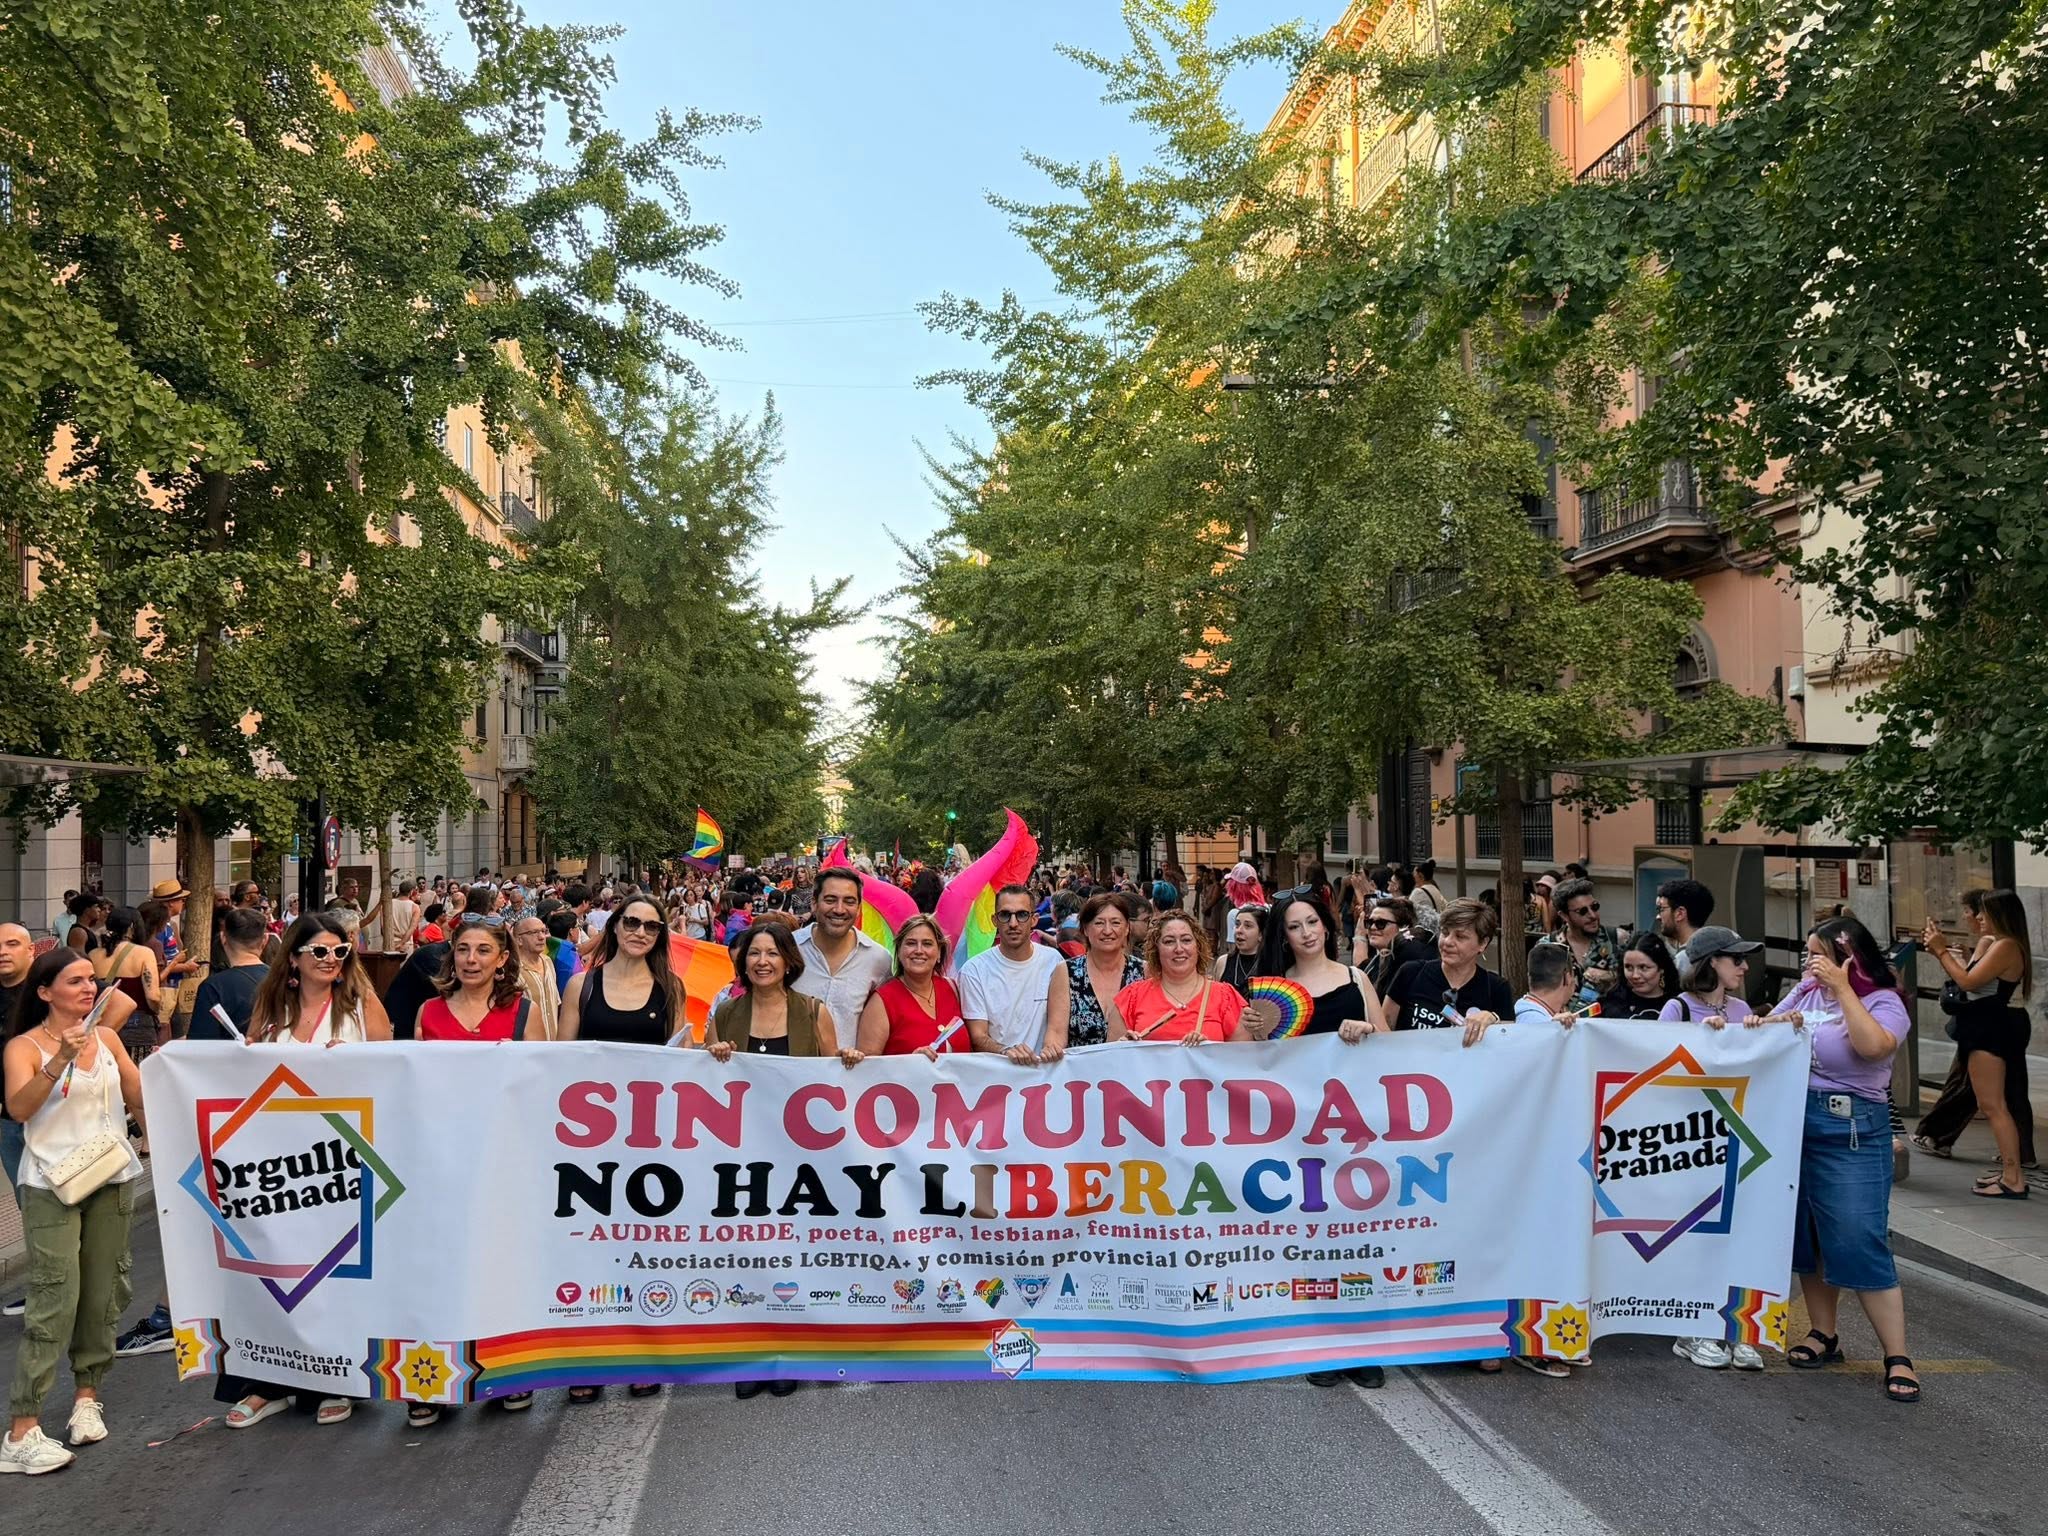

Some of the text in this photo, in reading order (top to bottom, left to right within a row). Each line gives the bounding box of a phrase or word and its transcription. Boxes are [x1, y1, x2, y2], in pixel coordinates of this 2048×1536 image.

[555, 1073, 1453, 1151] SIN COMUNIDAD
[553, 1137, 1454, 1219] NO HAY LIBERACIÓN
[699, 1222, 801, 1244] LORDE,
[807, 1225, 886, 1246] poeta,
[892, 1225, 964, 1245] negra,
[970, 1224, 1081, 1242] lesbiana,
[1087, 1220, 1212, 1241] feminista,
[1219, 1220, 1298, 1237] madre
[1305, 1221, 1320, 1240] y
[1326, 1216, 1438, 1240] guerrera.
[627, 1243, 1385, 1273] Asociaciones LGBTIQA+ y comisión provincial Orgullo Granada
[1239, 1283, 1274, 1300] UGT
[1295, 1283, 1334, 1294] CCOO
[1340, 1286, 1373, 1298] USTEA
[891, 1303, 926, 1311] FAMILIAS
[234, 1337, 353, 1366] @OrgulloGranada
[240, 1349, 349, 1377] @GranadaLGBTI
